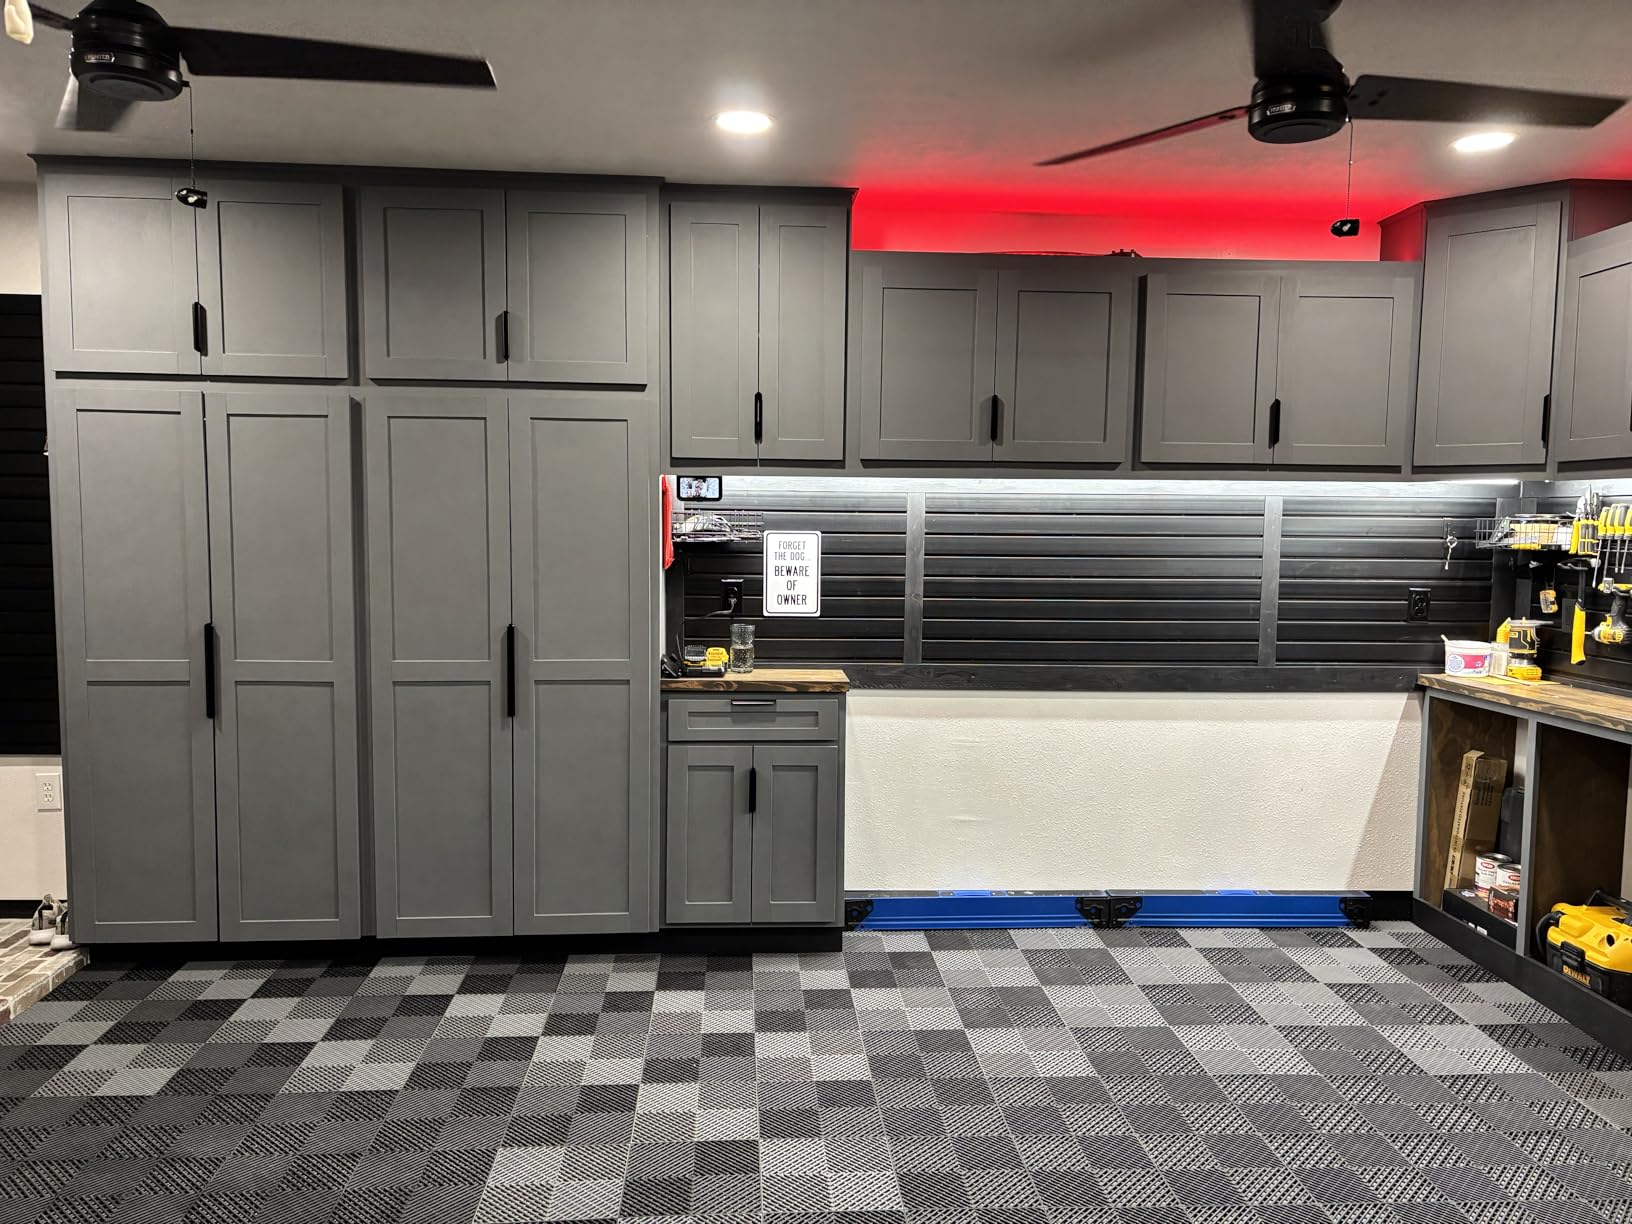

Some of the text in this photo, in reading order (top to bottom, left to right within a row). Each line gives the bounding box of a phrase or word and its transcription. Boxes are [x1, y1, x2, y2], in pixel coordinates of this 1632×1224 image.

[779, 541, 806, 550] FORGET
[774, 552, 787, 560] THE
[775, 566, 809, 576] BEWARE
[786, 580, 797, 591] OF
[777, 594, 807, 605] OWNER
[1562, 965, 1591, 986] DEWALT
